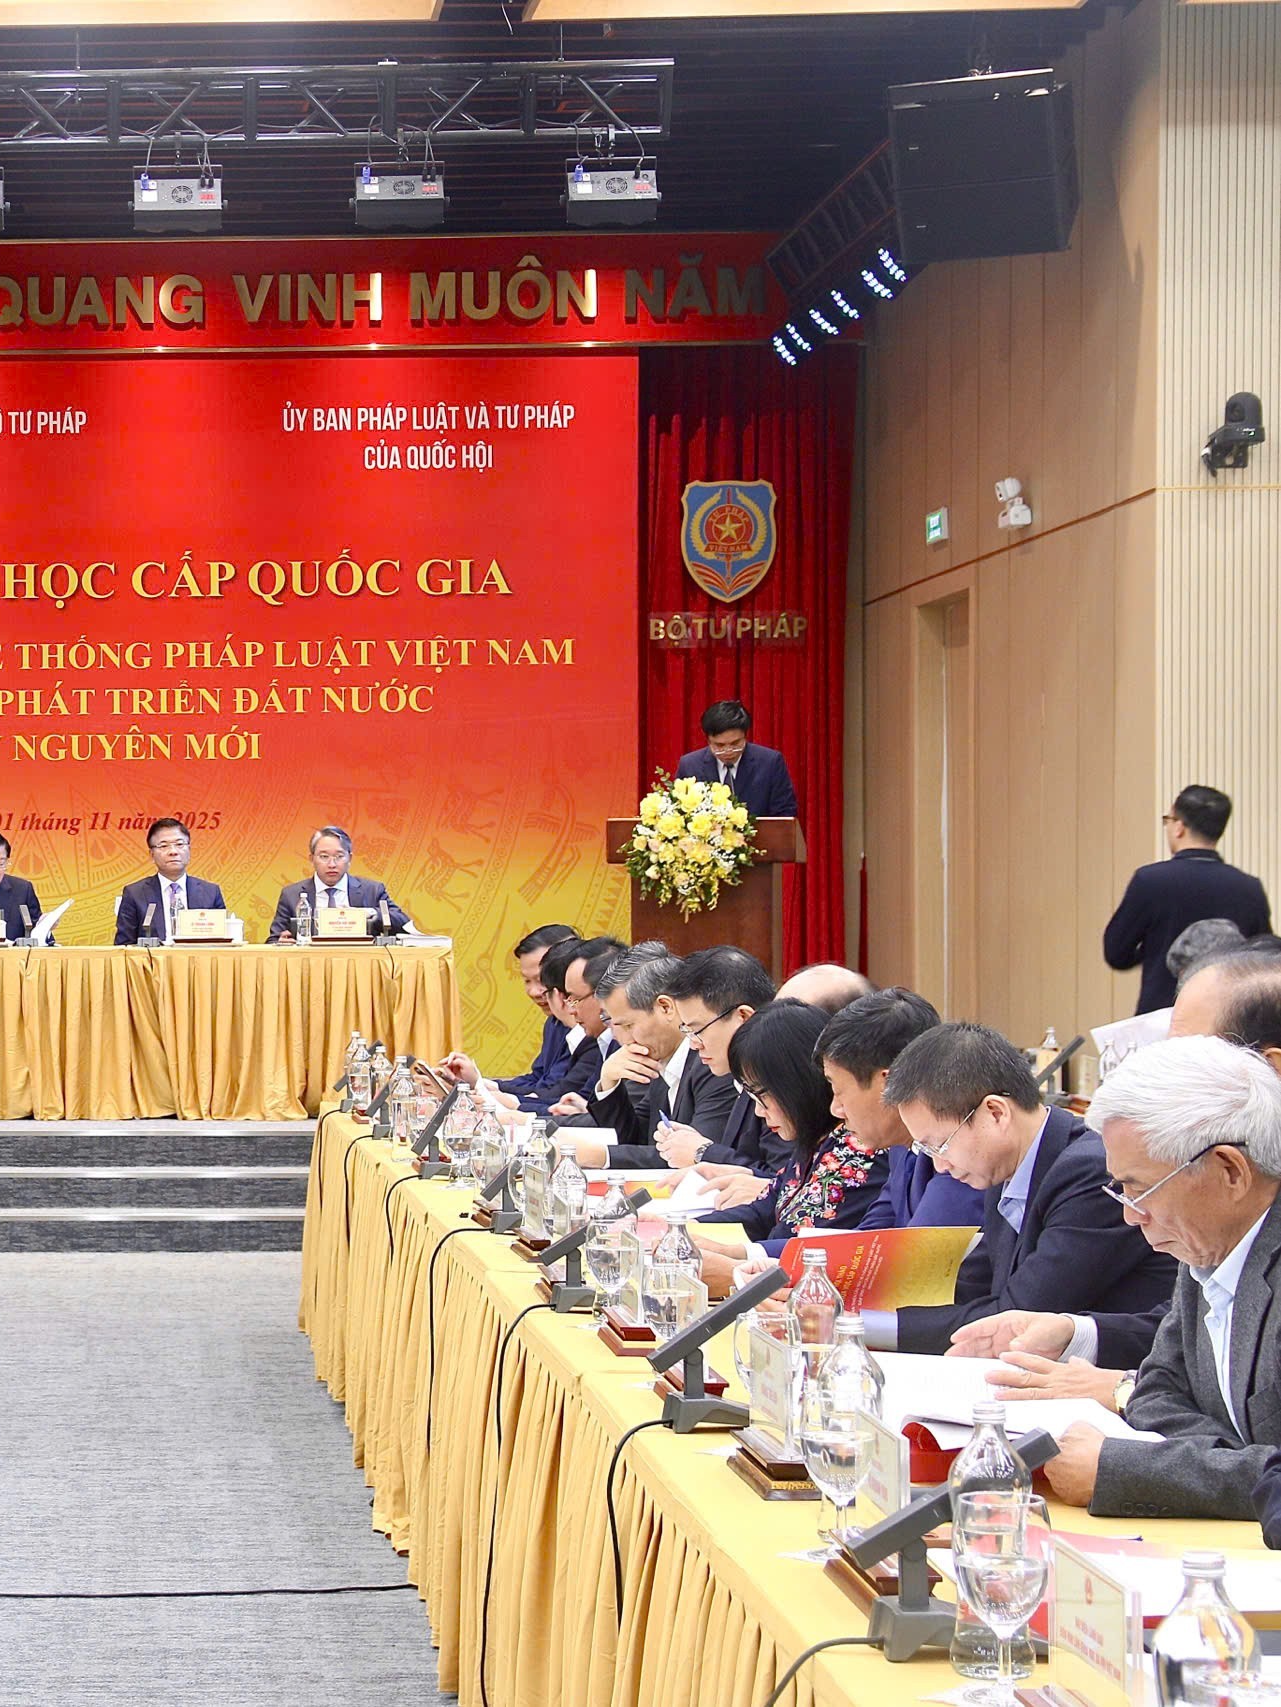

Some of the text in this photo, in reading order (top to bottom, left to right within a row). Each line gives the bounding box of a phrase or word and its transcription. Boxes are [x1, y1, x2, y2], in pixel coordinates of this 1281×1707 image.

[231, 271, 383, 323] VINH
[409, 255, 598, 321] MUÔN
[623, 252, 767, 318] NĂM
[7, 410, 34, 435] TƯ
[37, 406, 87, 434] PHÁP
[283, 400, 575, 435] ỦY BAN PHÁP LUẬT VÀ TƯ PHÁP
[364, 438, 493, 473] CỦA QUỐC HỘI
[1, 562, 115, 609] HỌC
[131, 550, 235, 598] CẤP
[248, 548, 400, 605] QUỐC
[416, 559, 513, 595] GIA
[649, 614, 687, 647] BỘ
[736, 612, 808, 640] PHÁP
[14, 634, 151, 670] THỐNG
[163, 633, 264, 668] PHÁP
[273, 635, 376, 675] LUẬT
[385, 635, 477, 674] VIỆT
[486, 638, 574, 665] NAM
[104, 680, 221, 715] TRIỂN
[232, 679, 312, 714] ĐẤT
[321, 680, 434, 713] NƯỚC
[12, 725, 173, 761] NGUYÊN
[184, 725, 261, 760] MỚI
[21, 811, 82, 836] tháng
[88, 811, 111, 831] 11
